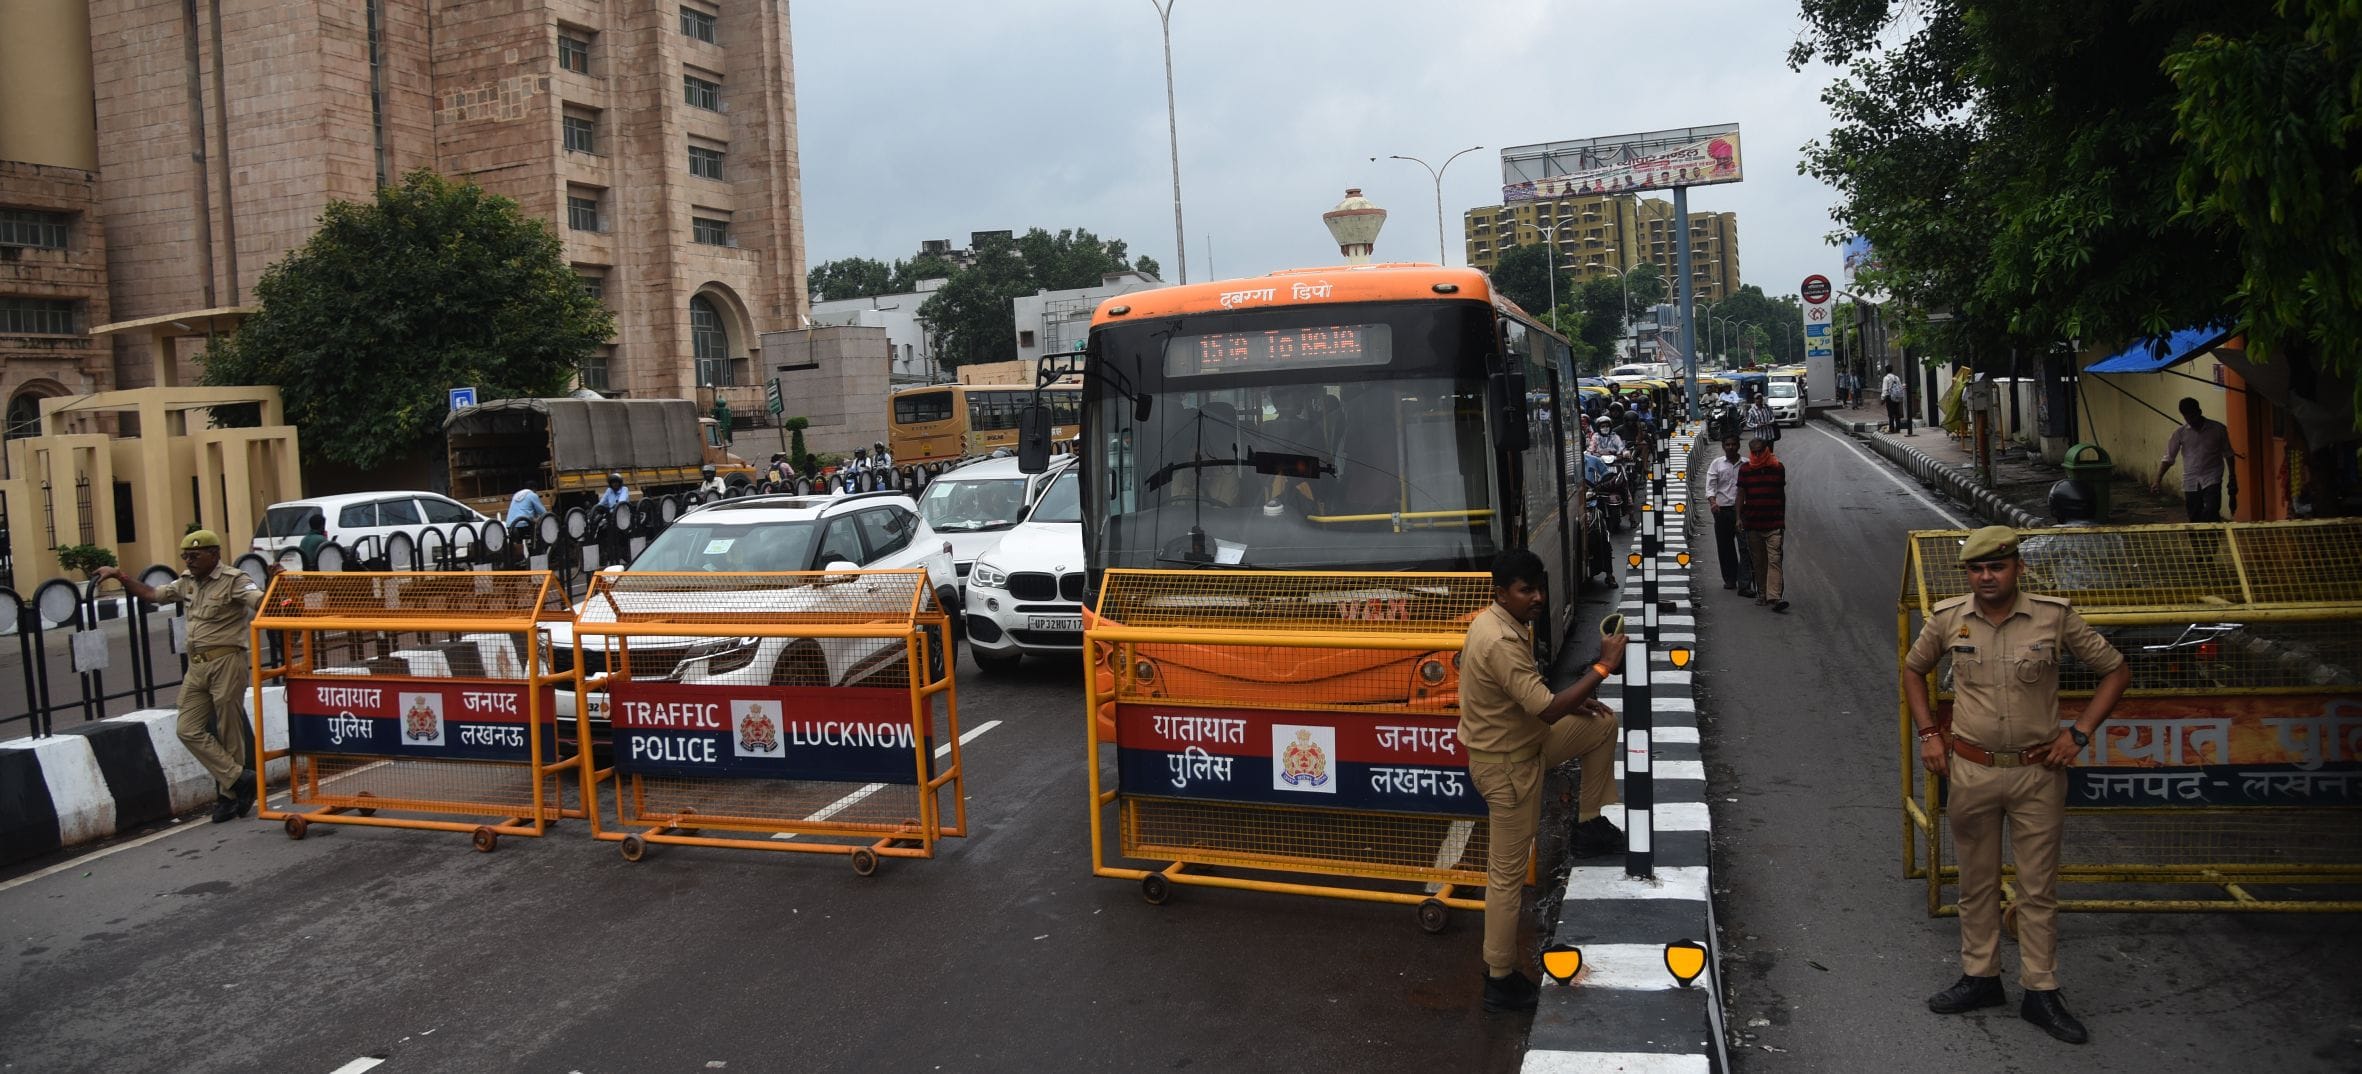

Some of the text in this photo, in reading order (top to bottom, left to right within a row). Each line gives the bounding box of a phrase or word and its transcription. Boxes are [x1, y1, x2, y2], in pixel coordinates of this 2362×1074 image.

[1291, 280, 1333, 300] डिपो
[1035, 619, 1082, 630] UP32HU717
[317, 686, 382, 709] यातायात
[462, 691, 518, 715] जनपद
[328, 710, 374, 745] पुलिस
[622, 701, 720, 728] TRAFFIC
[459, 724, 525, 748] लखनऊ
[791, 720, 916, 748] LUCKNOW
[1152, 715, 1247, 744] यातायात
[1374, 725, 1458, 755] जनपद
[631, 735, 717, 762] POLICE
[1166, 745, 1235, 789] पुलिस
[1369, 767, 1465, 797] लखनऊ
[2080, 772, 2211, 803] जनपद
